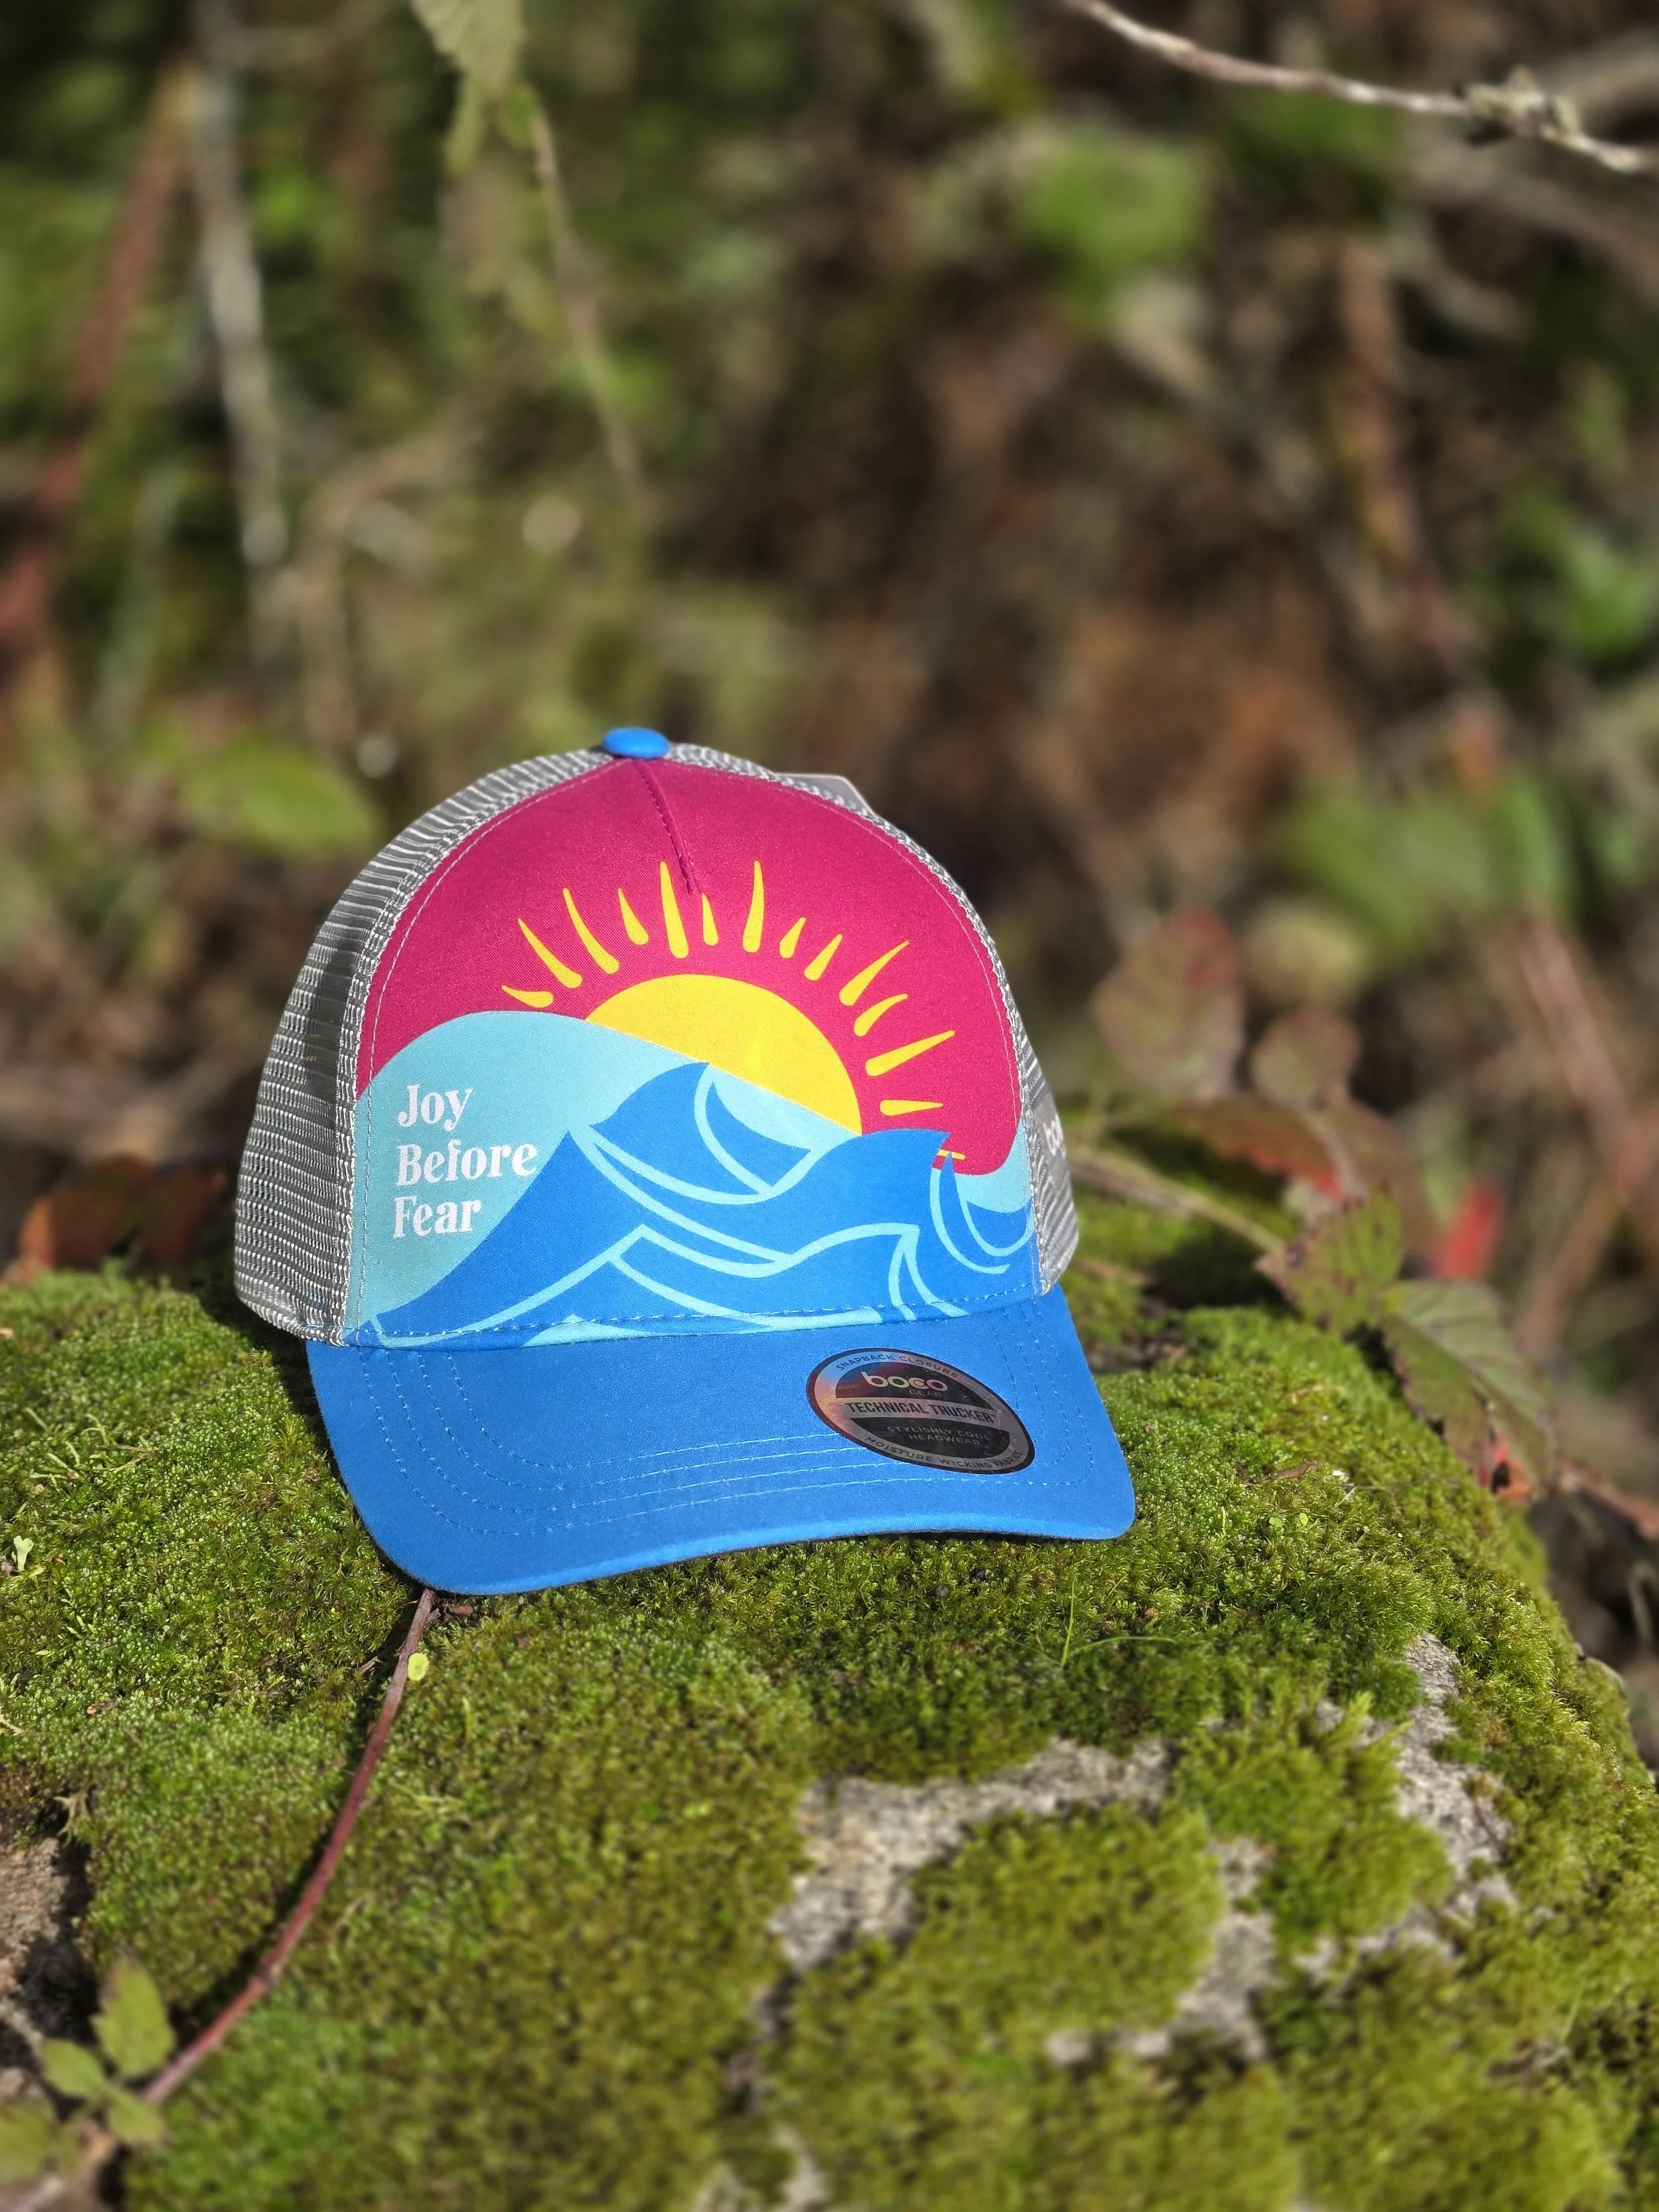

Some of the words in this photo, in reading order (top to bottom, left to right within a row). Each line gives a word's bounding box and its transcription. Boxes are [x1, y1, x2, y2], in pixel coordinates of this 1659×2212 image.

[398, 1083, 474, 1132] Joy
[396, 1138, 538, 1186] Before
[393, 1195, 482, 1239] Fear
[836, 1354, 896, 1370] SNAPBACK
[899, 1355, 960, 1378] CLOSURE
[861, 1371, 948, 1392] boco
[909, 1389, 942, 1398] GEAR
[845, 1402, 929, 1414] TECHNICAL
[928, 1404, 995, 1424] TRUCKER
[887, 1426, 952, 1435] STYLISHLY
[958, 1430, 991, 1441] COOL
[908, 1434, 981, 1445] HEADWEAR
[865, 1436, 933, 1461] MOISTURE
[937, 1458, 991, 1469] WICKING
[994, 1449, 1023, 1468] FABRICS
